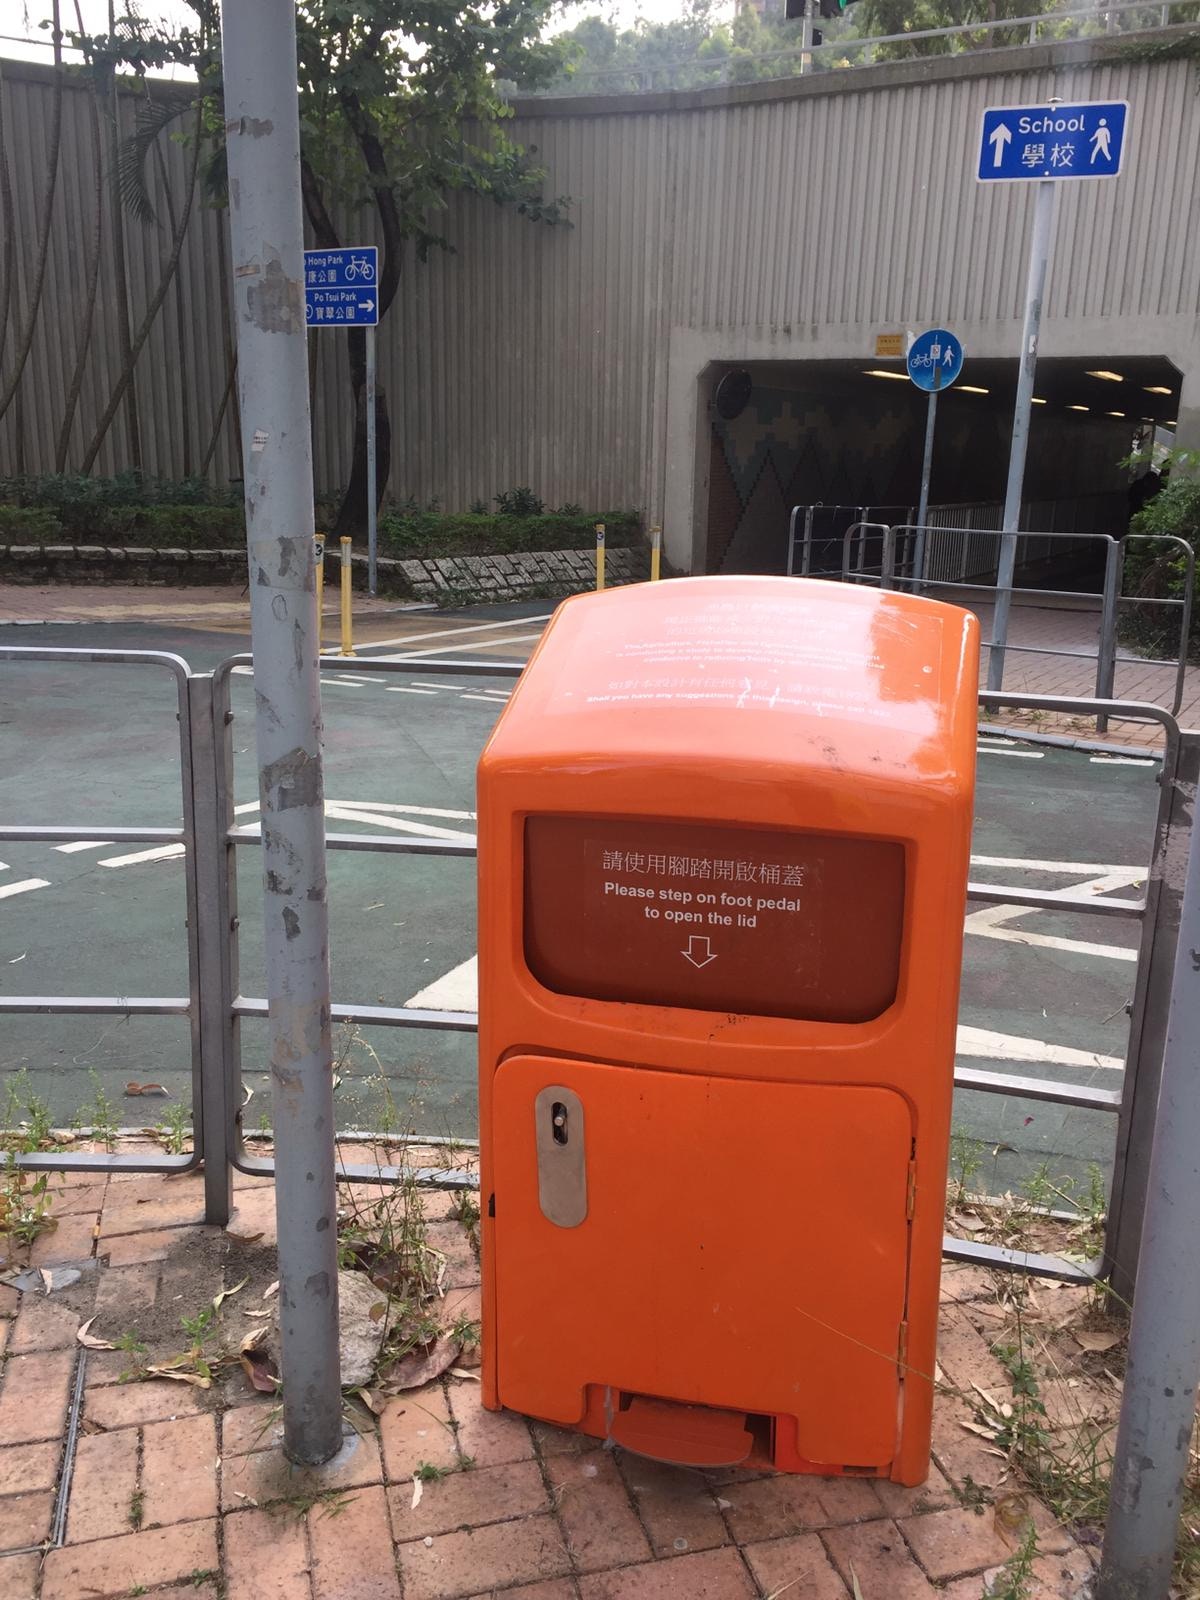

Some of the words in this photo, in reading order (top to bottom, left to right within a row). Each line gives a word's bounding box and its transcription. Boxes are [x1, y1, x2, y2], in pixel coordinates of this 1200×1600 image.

[1018, 114, 1085, 135] School
[1021, 142, 1076, 168] 學校
[308, 256, 326, 267] Hong
[327, 255, 344, 265] Park
[304, 269, 337, 283] 康公園
[314, 293, 324, 302] Po
[325, 292, 340, 302] Tsui
[340, 292, 357, 301] Park
[604, 881, 655, 899] Please
[658, 887, 692, 904] step
[696, 893, 717, 905] on
[720, 892, 753, 908] foot
[756, 896, 801, 912] pedal
[644, 905, 660, 919] to
[664, 909, 703, 924] open
[707, 909, 733, 925] the
[737, 914, 757, 928] lid
